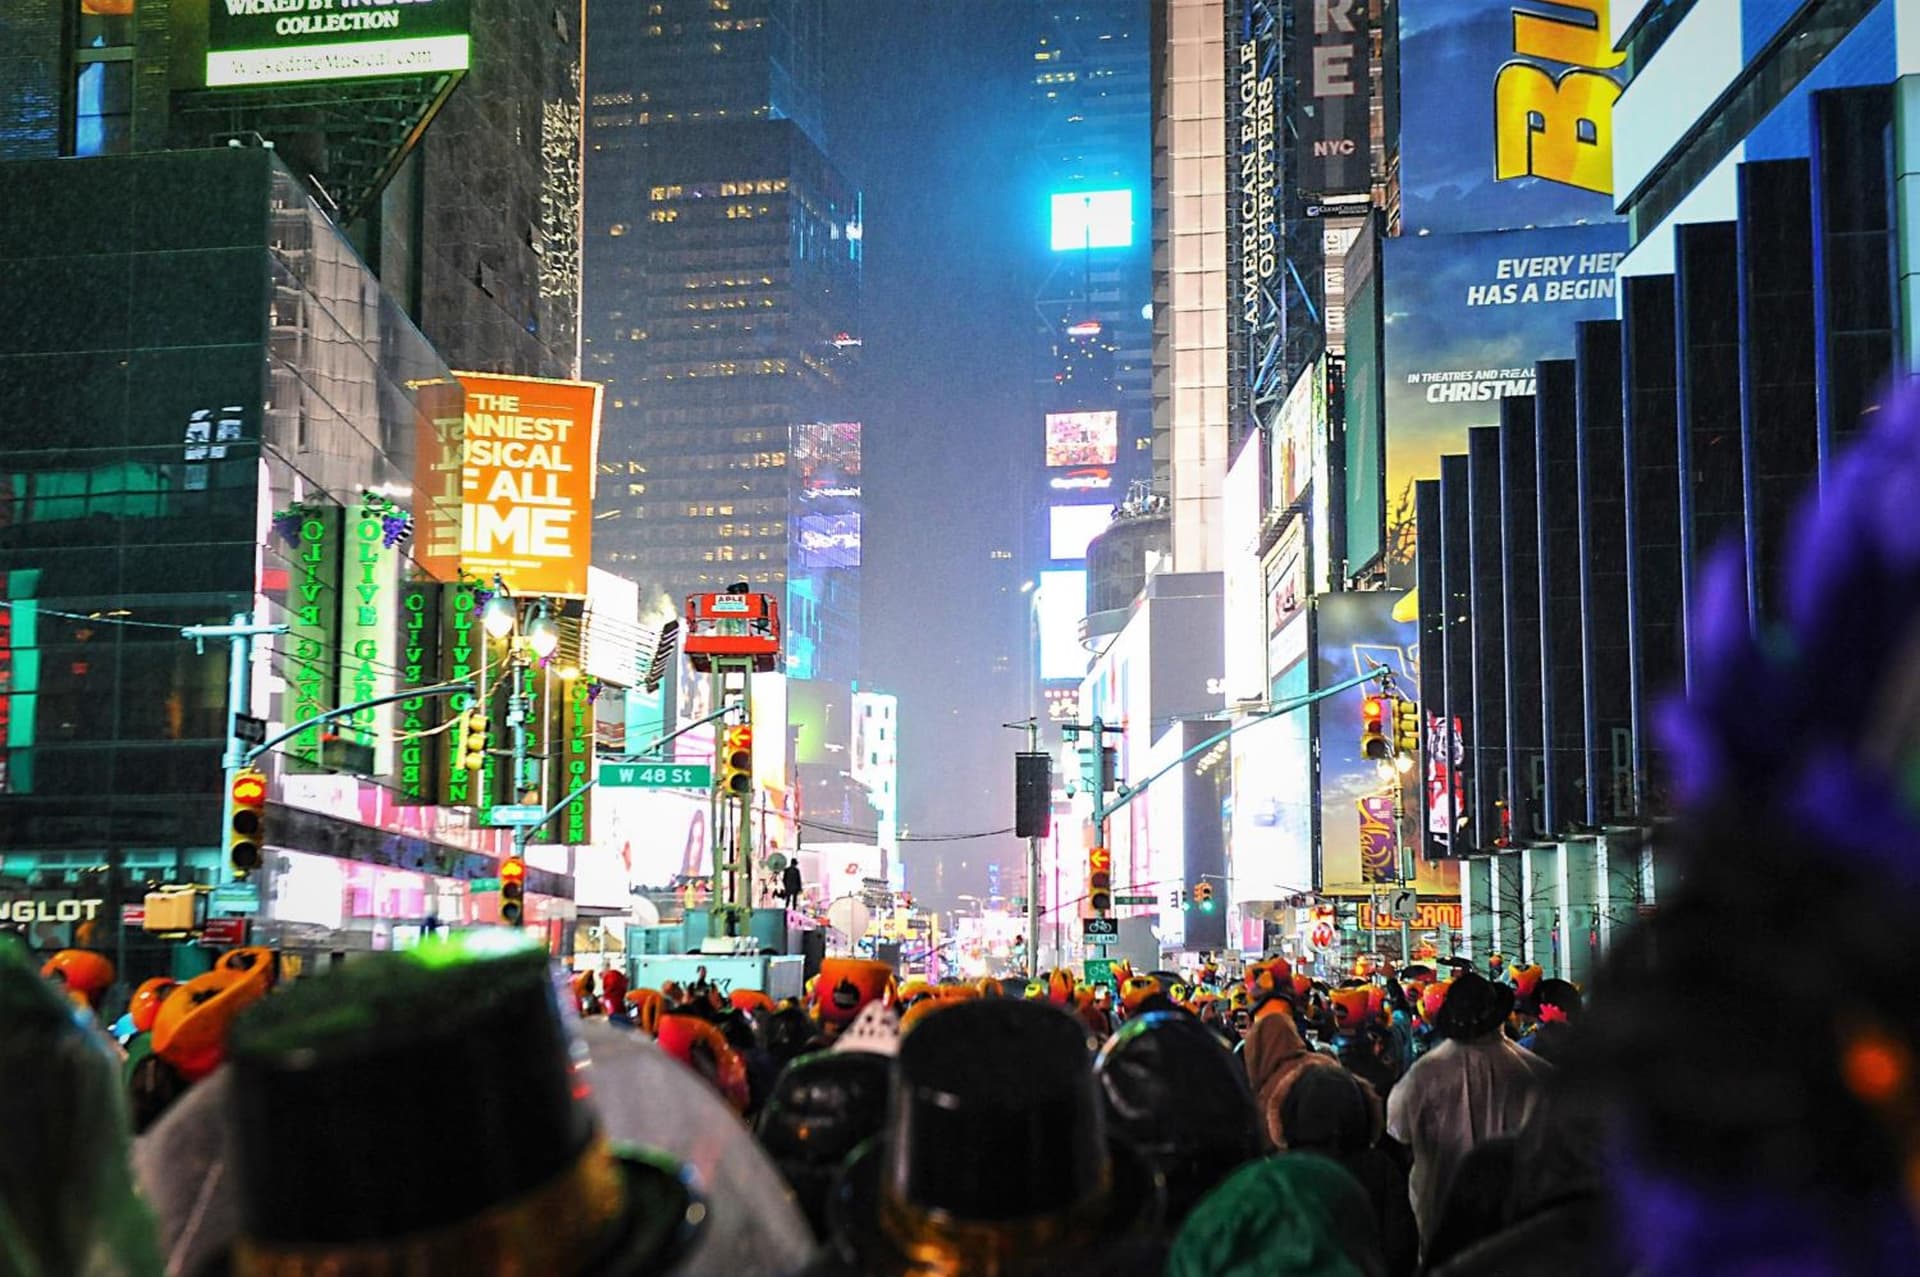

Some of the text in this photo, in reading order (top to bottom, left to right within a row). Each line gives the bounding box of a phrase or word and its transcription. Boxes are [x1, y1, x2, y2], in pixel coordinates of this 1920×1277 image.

[275, 10, 400, 35] COLLECTION
[1314, 140, 1355, 156] NYC
[1241, 40, 1258, 331] AMERICAN EAGLE
[1258, 77, 1274, 278] OUTFITTERS
[1497, 256, 1575, 279] EVERY
[1467, 284, 1518, 306] HAS
[1521, 283, 1540, 303] A
[1407, 374, 1420, 383] IN
[1422, 371, 1474, 383] THEATRES
[1475, 369, 1498, 380] AND
[468, 393, 520, 413] THE
[486, 469, 572, 506] ALL
[356, 519, 382, 627] OLIVE
[619, 768, 692, 783] W 48 St
